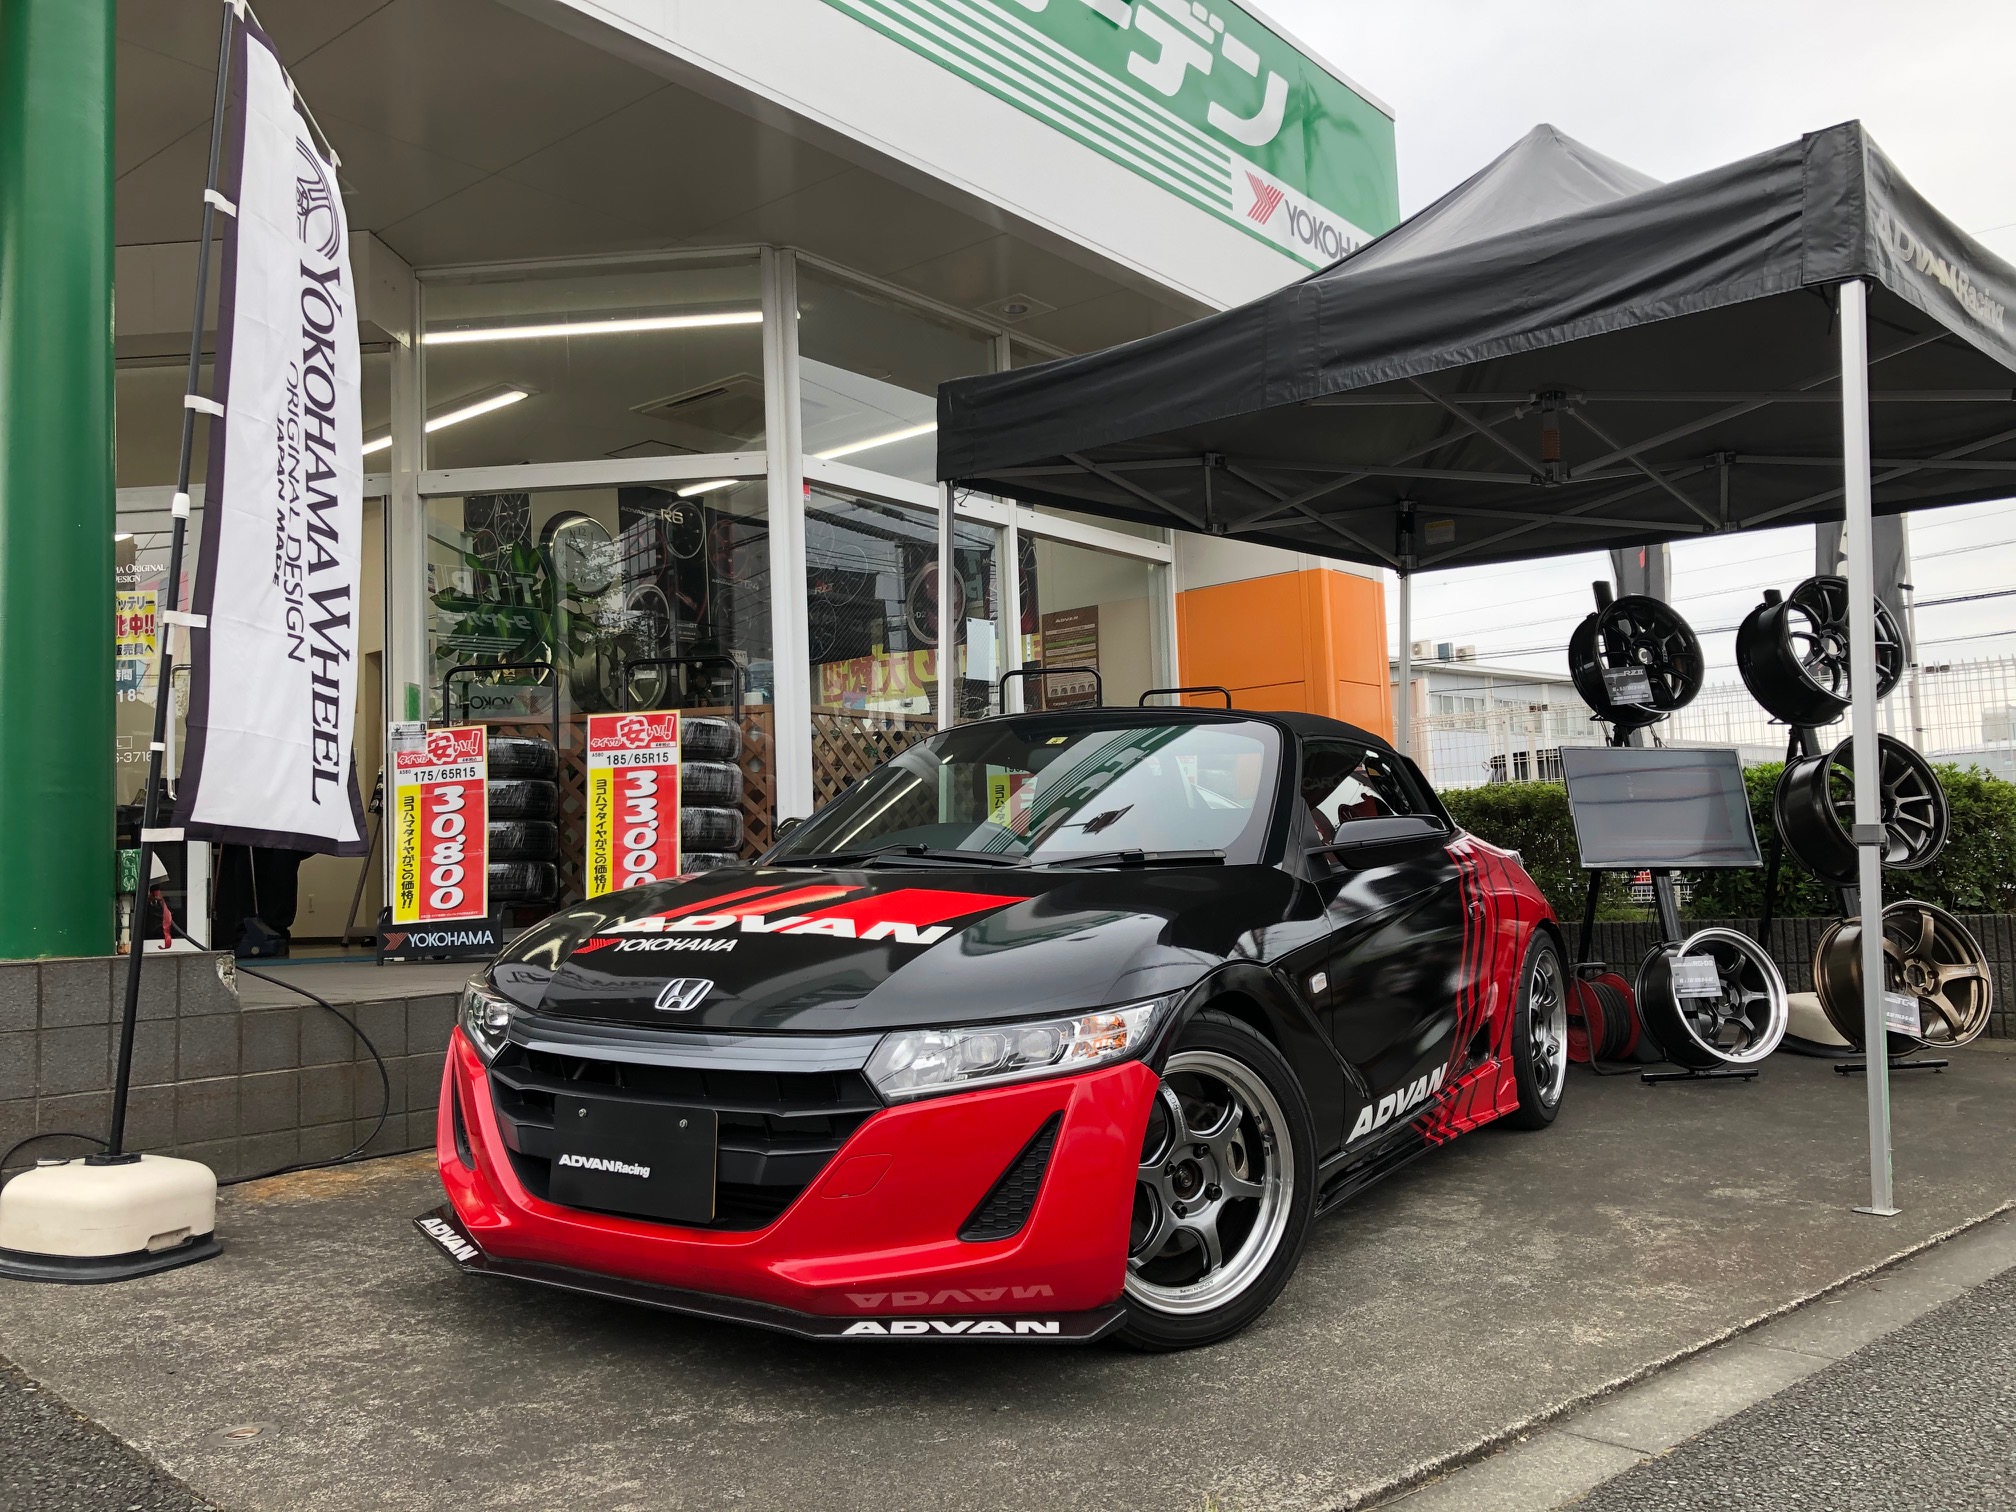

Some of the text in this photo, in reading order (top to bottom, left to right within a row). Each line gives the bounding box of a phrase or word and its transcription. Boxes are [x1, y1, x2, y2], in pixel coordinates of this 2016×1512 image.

[1285, 199, 1360, 260] YOKOH
[284, 361, 305, 663] ORIGINAL DESIGN
[660, 508, 684, 525] R6
[272, 507, 286, 587] MADE
[300, 258, 351, 806] YOKOHAMA WHEEL
[116, 575, 141, 584] ESIGN
[126, 563, 167, 574] ORIGINAL
[413, 767, 476, 783] 175/65R15
[606, 752, 669, 766] 185/65R15
[400, 795, 416, 909] ヨコハマタイヤがこの価格!!
[429, 785, 467, 910] 30,800
[594, 778, 608, 893] ヨコハマタイヤがこの価格!!
[408, 930, 495, 948] YOKOHAMA
[599, 914, 954, 945] ADVAN
[613, 938, 739, 952] YOKOHAMA
[1345, 1061, 1449, 1145] ADVAN
[420, 1217, 479, 1262] ADVAN
[841, 1321, 1060, 1336] ADVAN
